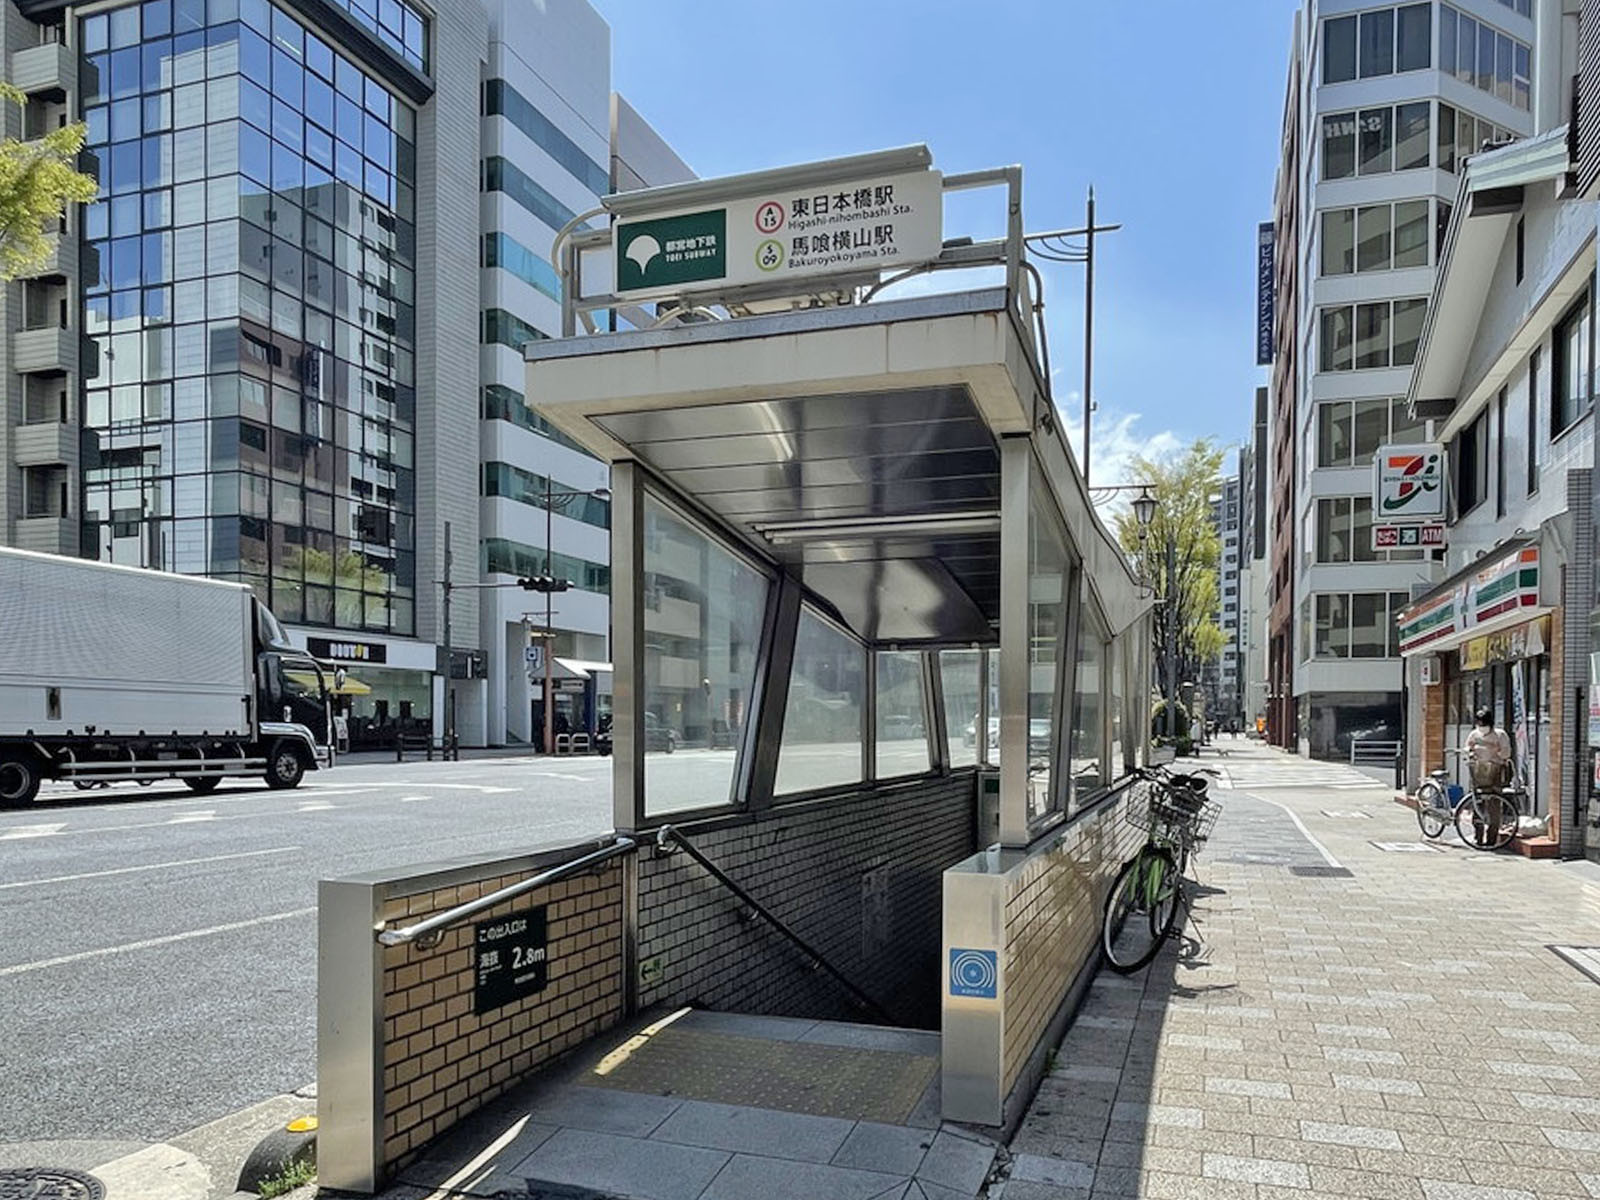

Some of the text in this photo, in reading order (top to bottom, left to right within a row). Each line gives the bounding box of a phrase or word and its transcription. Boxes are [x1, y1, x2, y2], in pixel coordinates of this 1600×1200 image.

[766, 207, 773, 216] A
[791, 185, 893, 218] 東日本橋駅
[763, 216, 777, 228] 15
[788, 204, 914, 230] Higashi-nihombashi Sta.
[791, 224, 893, 256] 馬喰横山駅
[763, 254, 777, 266] 09
[788, 245, 900, 269] Bakuroyokoyama Sta.
[1422, 528, 1442, 542] ATM
[479, 920, 527, 942] この出入口は
[512, 946, 545, 970] 2.8m
